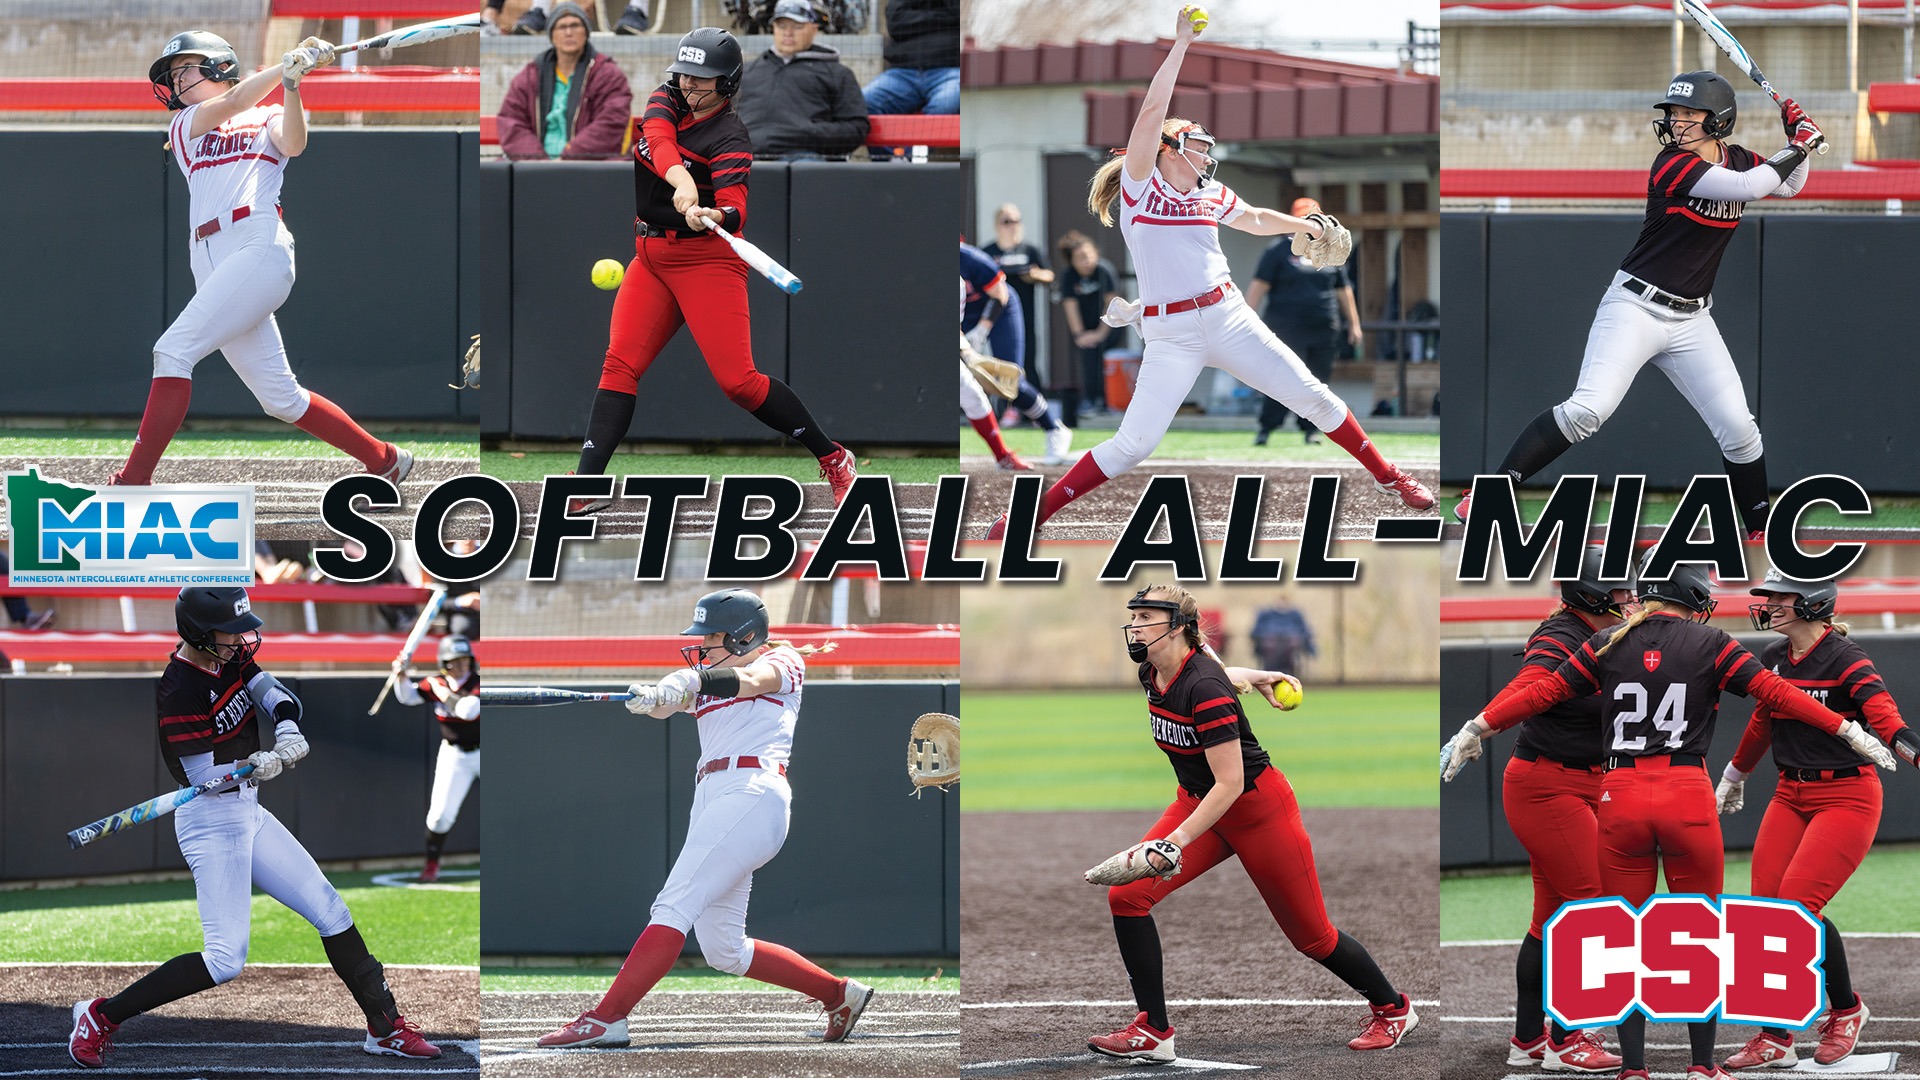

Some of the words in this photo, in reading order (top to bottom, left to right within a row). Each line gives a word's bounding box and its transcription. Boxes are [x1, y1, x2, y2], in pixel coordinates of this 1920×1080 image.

[678, 46, 706, 65] CSB
[1667, 81, 1695, 98] CSB
[1647, 584, 1659, 594] 24
[1611, 682, 1689, 750] 24
